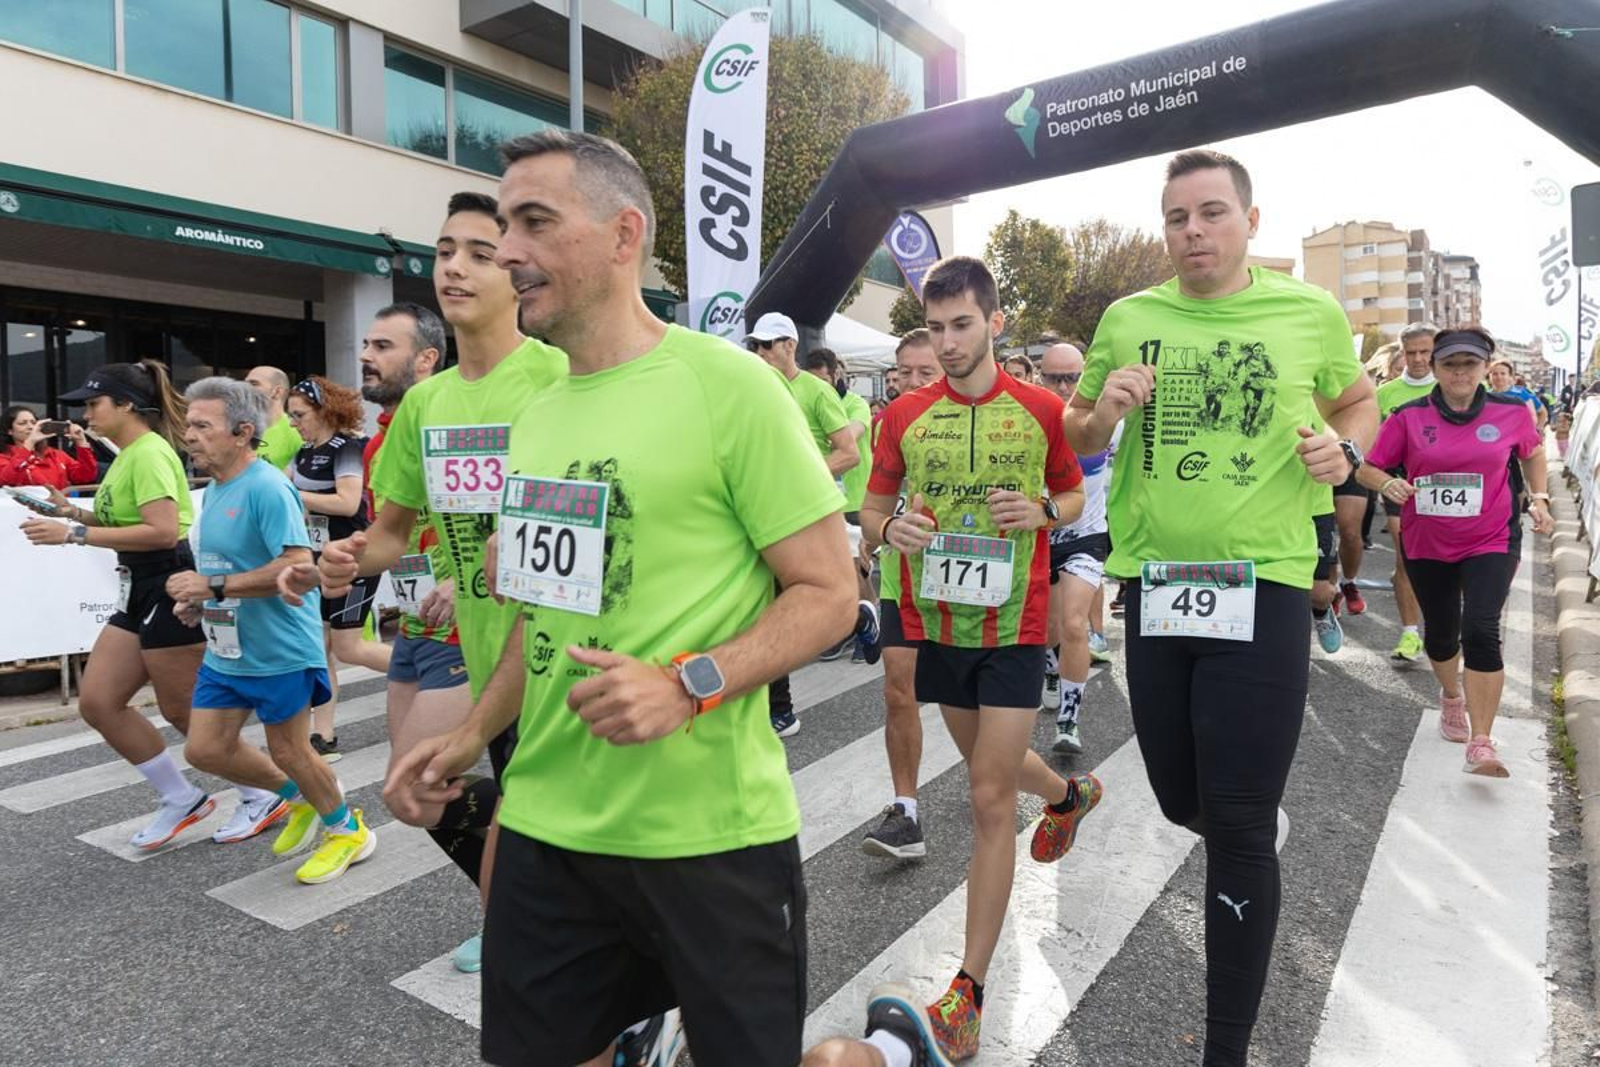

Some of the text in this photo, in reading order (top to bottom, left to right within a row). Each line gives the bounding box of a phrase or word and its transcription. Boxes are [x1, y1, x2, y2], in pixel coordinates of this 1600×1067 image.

[715, 59, 759, 77] CSIF
[1046, 55, 1247, 118] Patronato Municipal de
[1047, 88, 1199, 137] Deportes de Jaén
[699, 128, 752, 262] CSIF
[1139, 339, 1161, 368] 17
[1162, 346, 1199, 370] XI
[444, 457, 504, 492] 533
[1182, 459, 1211, 472] CSIF
[1429, 488, 1469, 507] 164
[515, 521, 577, 577] 150
[939, 558, 989, 589] 171
[1170, 587, 1218, 618] 49
